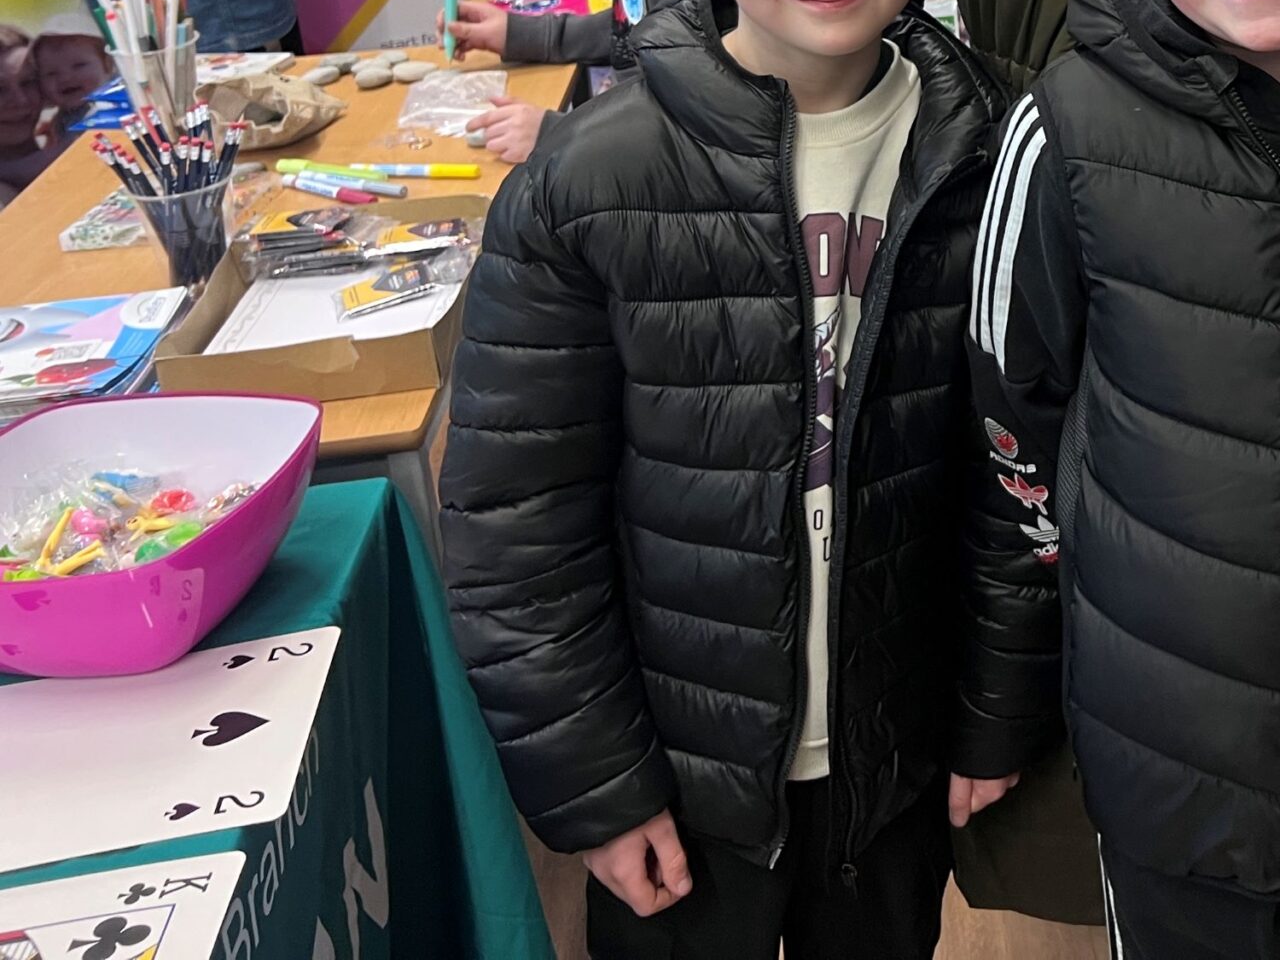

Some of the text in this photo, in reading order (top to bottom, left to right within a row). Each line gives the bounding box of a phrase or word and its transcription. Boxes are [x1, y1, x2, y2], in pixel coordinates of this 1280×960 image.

[268, 641, 314, 662] 2
[213, 790, 265, 815] 2
[158, 872, 213, 900] K
